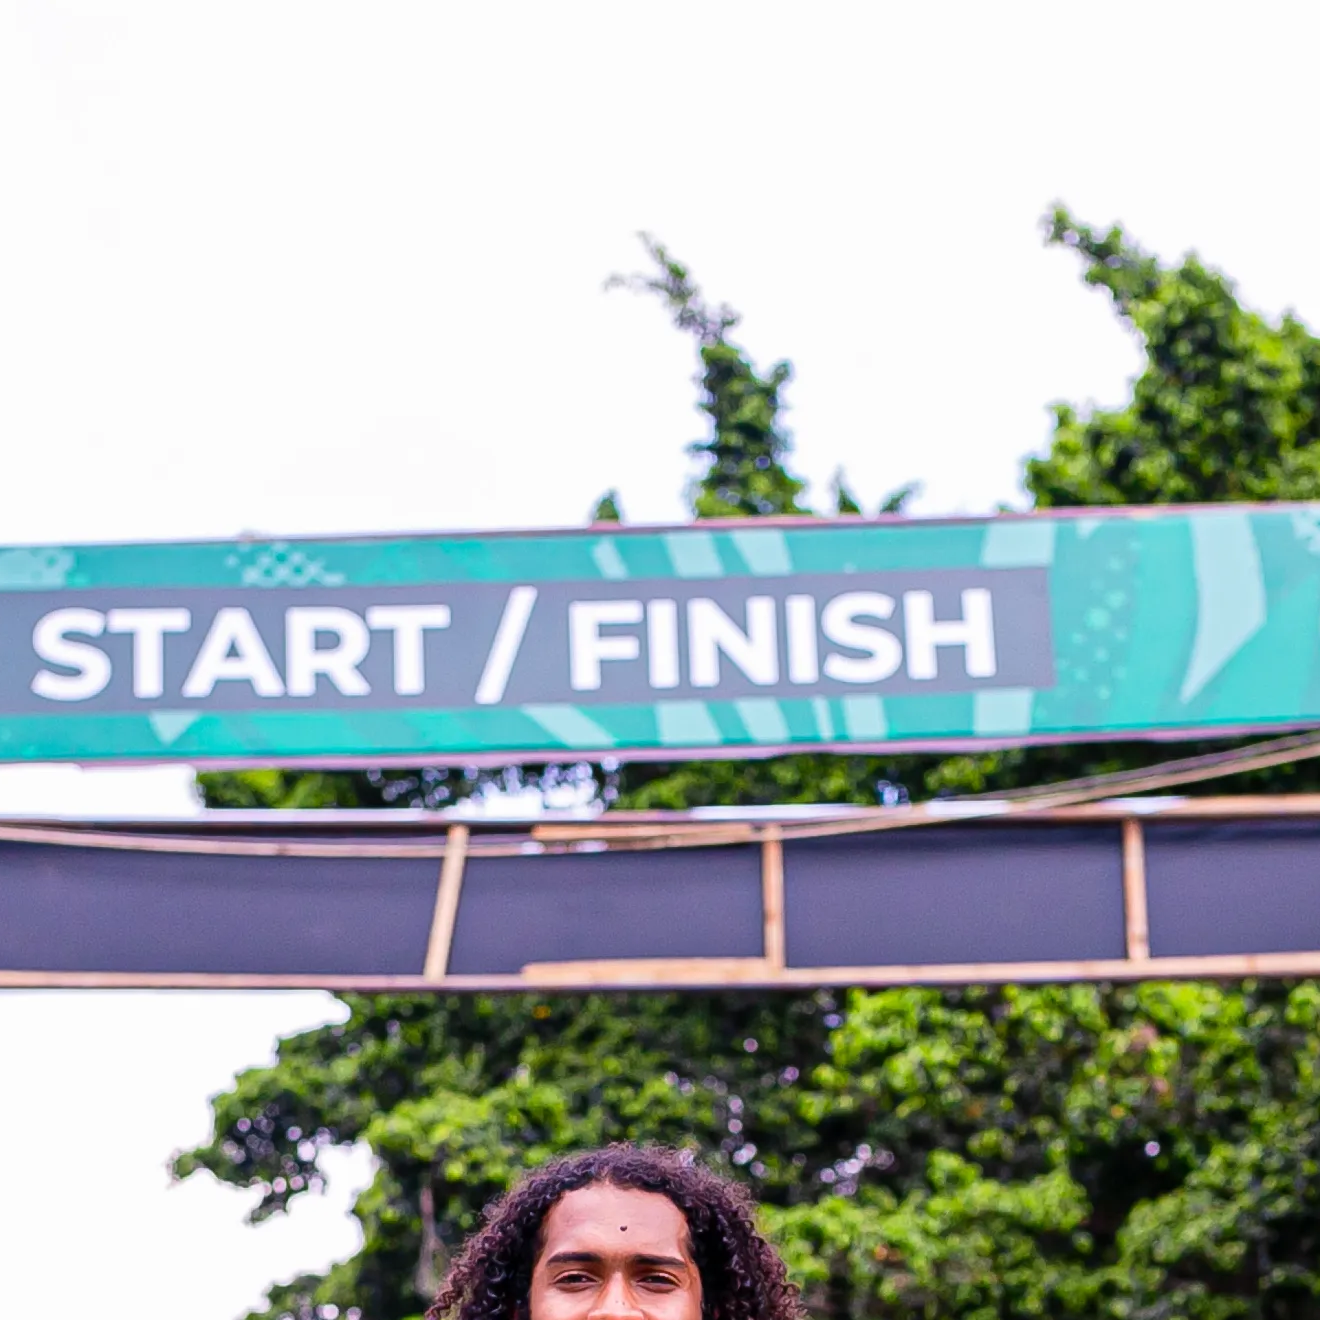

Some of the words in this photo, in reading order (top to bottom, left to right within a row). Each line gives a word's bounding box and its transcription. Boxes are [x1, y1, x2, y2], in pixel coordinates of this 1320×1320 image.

[30, 604, 452, 702] START
[474, 585, 538, 704] /
[568, 587, 998, 692] FINISH
